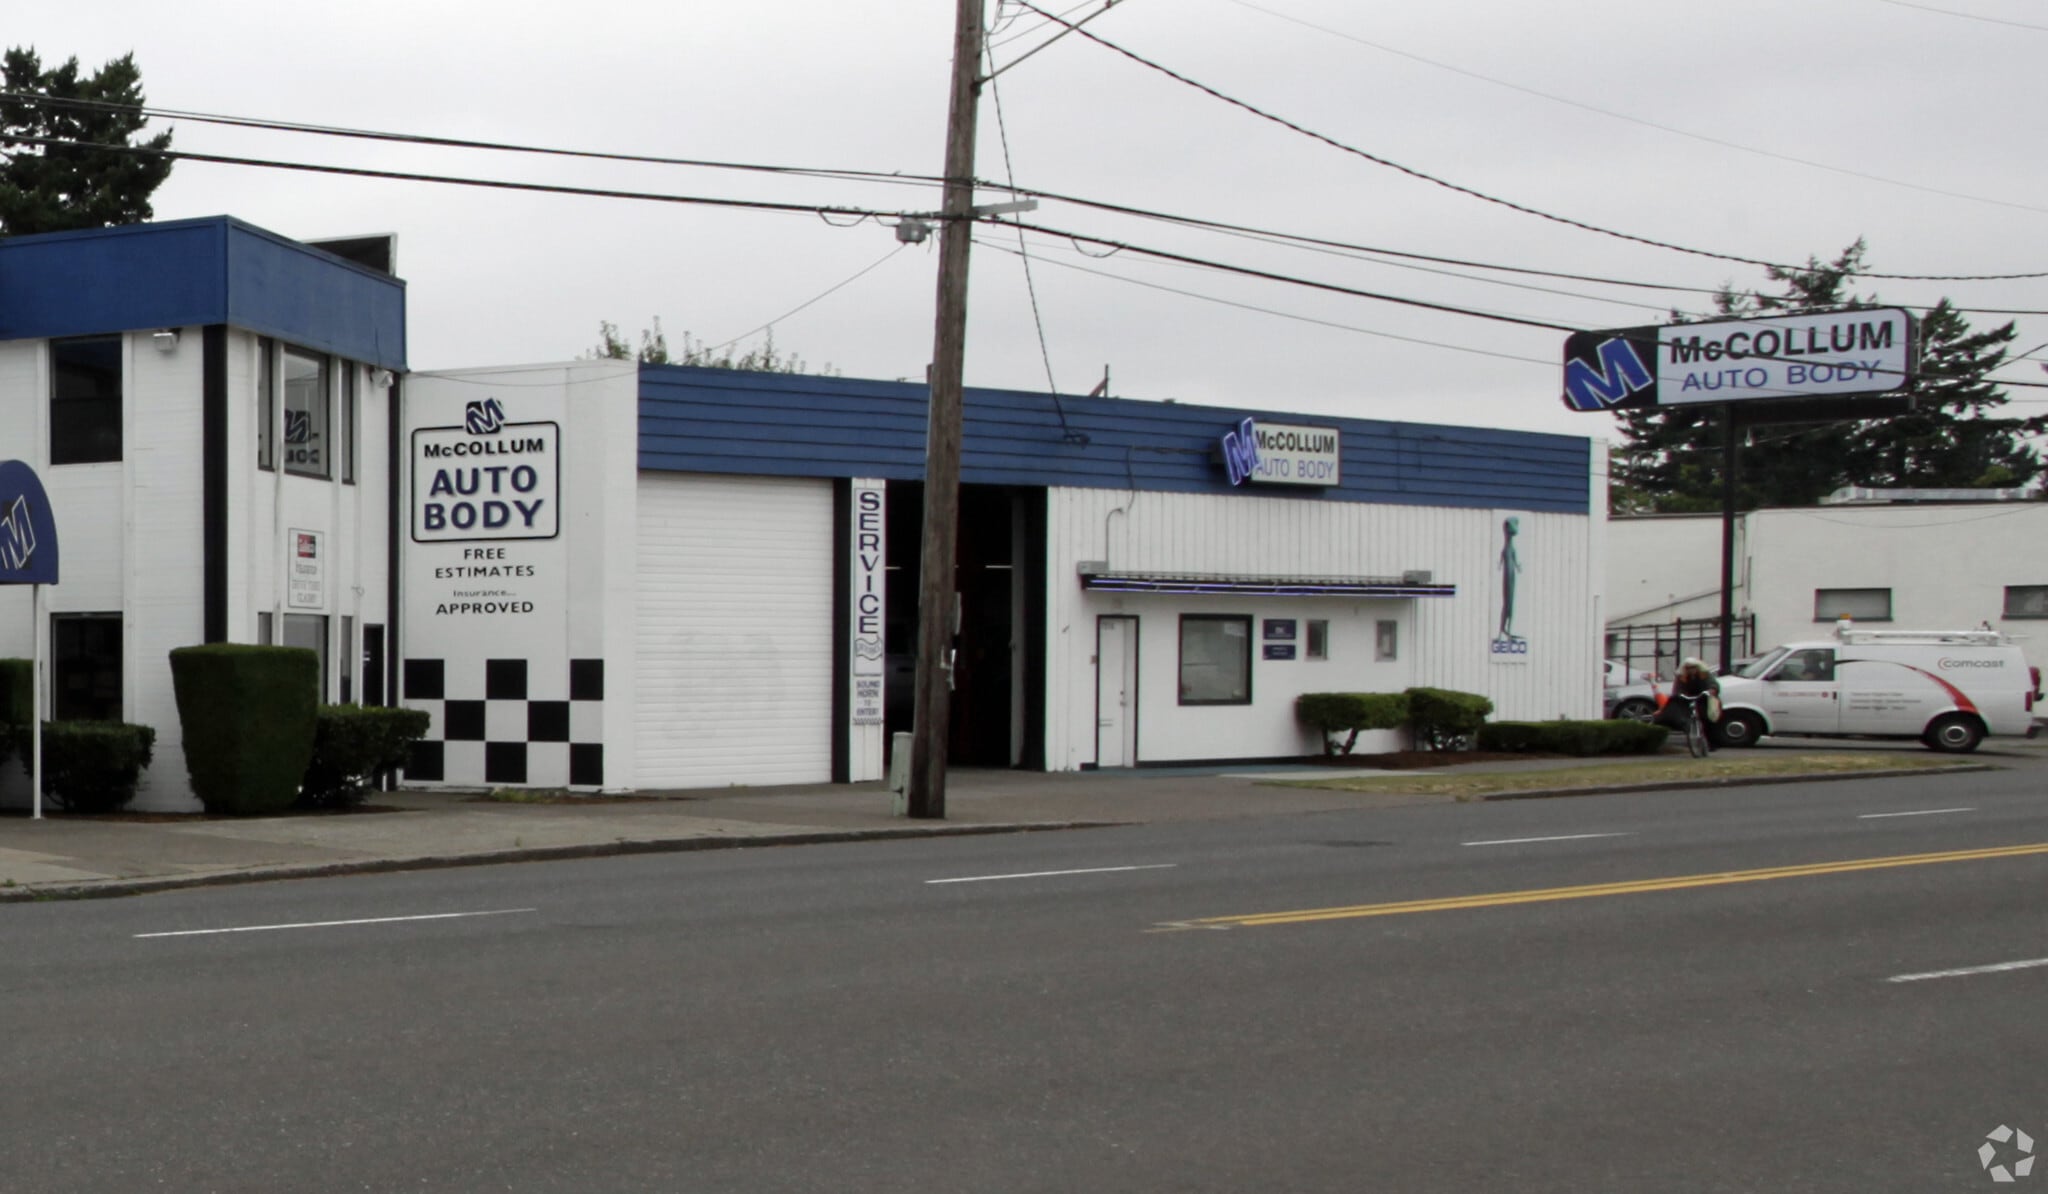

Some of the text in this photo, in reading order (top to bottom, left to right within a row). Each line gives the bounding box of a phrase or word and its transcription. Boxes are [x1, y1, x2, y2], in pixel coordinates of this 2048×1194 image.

[1670, 320, 1893, 364] McCOLLUM
[1681, 359, 1881, 392] AUTO BODY
[423, 438, 544, 458] McCOLLUM
[1256, 430, 1335, 454] McCOLLUM
[1254, 458, 1334, 479] AUTO BODY
[429, 465, 538, 498] AUTO
[424, 500, 544, 531] BODY
[463, 548, 506, 560] FREE
[859, 491, 880, 634] SERVICE
[435, 565, 535, 579] ESTIMATES
[436, 601, 534, 615] APPROVED
